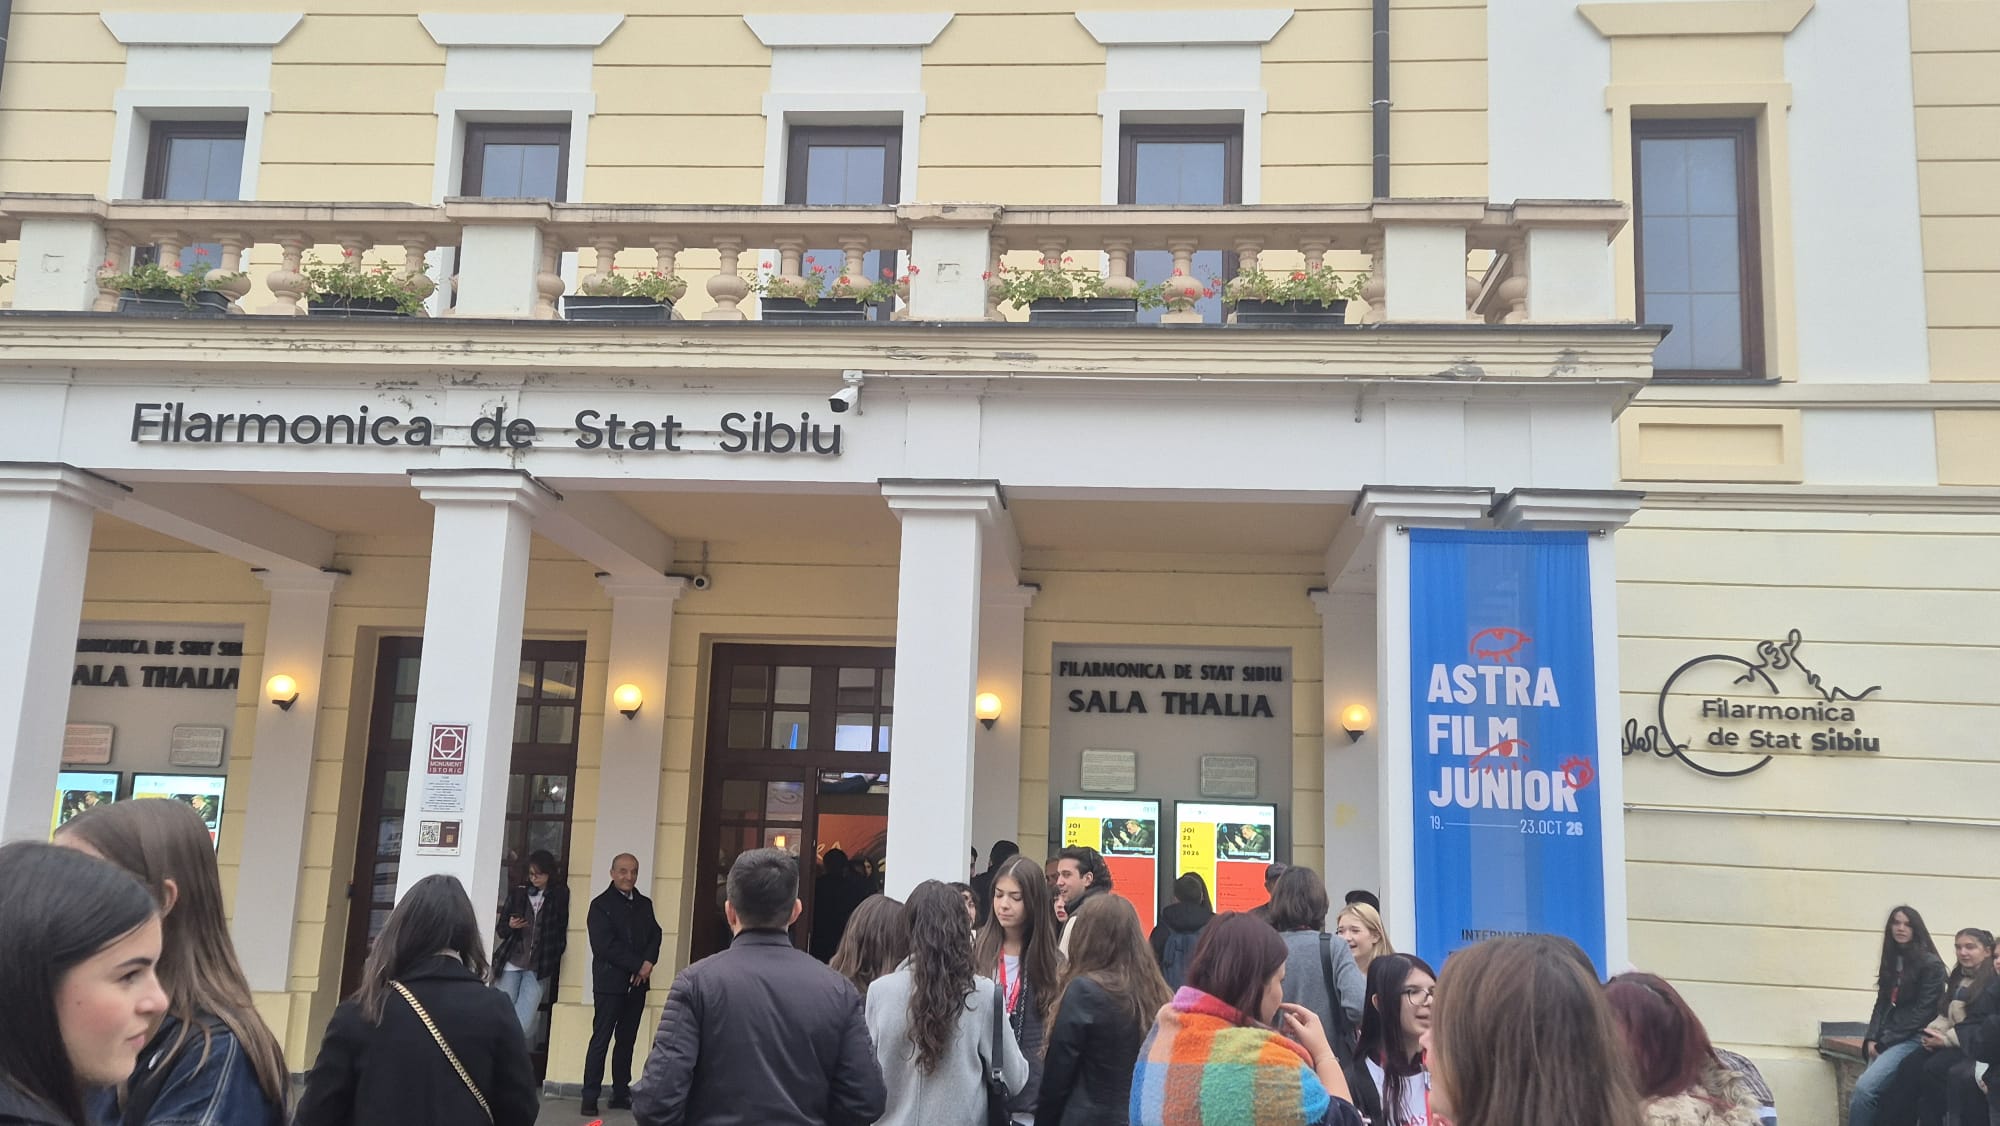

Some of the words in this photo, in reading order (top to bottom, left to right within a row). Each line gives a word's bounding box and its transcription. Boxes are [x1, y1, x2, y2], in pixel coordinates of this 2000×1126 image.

[130, 402, 433, 446] Filarmonica
[470, 406, 537, 449] de
[574, 409, 682, 451] Stat
[719, 411, 841, 455] Sibiu
[72, 665, 129, 687] ALA
[140, 666, 240, 689] THALIA
[1059, 661, 1166, 679] FILARMONICA
[1174, 663, 1193, 680] DE
[1200, 664, 1235, 681] STAT
[1242, 665, 1283, 682] SIBIU
[1427, 663, 1561, 708] ASTRA
[1068, 689, 1147, 714] SALA
[1161, 691, 1274, 718] THALIA
[1701, 697, 1856, 722] Filarmonica
[1428, 714, 1519, 758] FILM
[1707, 726, 1740, 747] de
[1750, 728, 1803, 750] Stat
[1811, 727, 1881, 753] Sibiu
[1428, 766, 1579, 813] JUNIOR
[1565, 821, 1584, 836] 26
